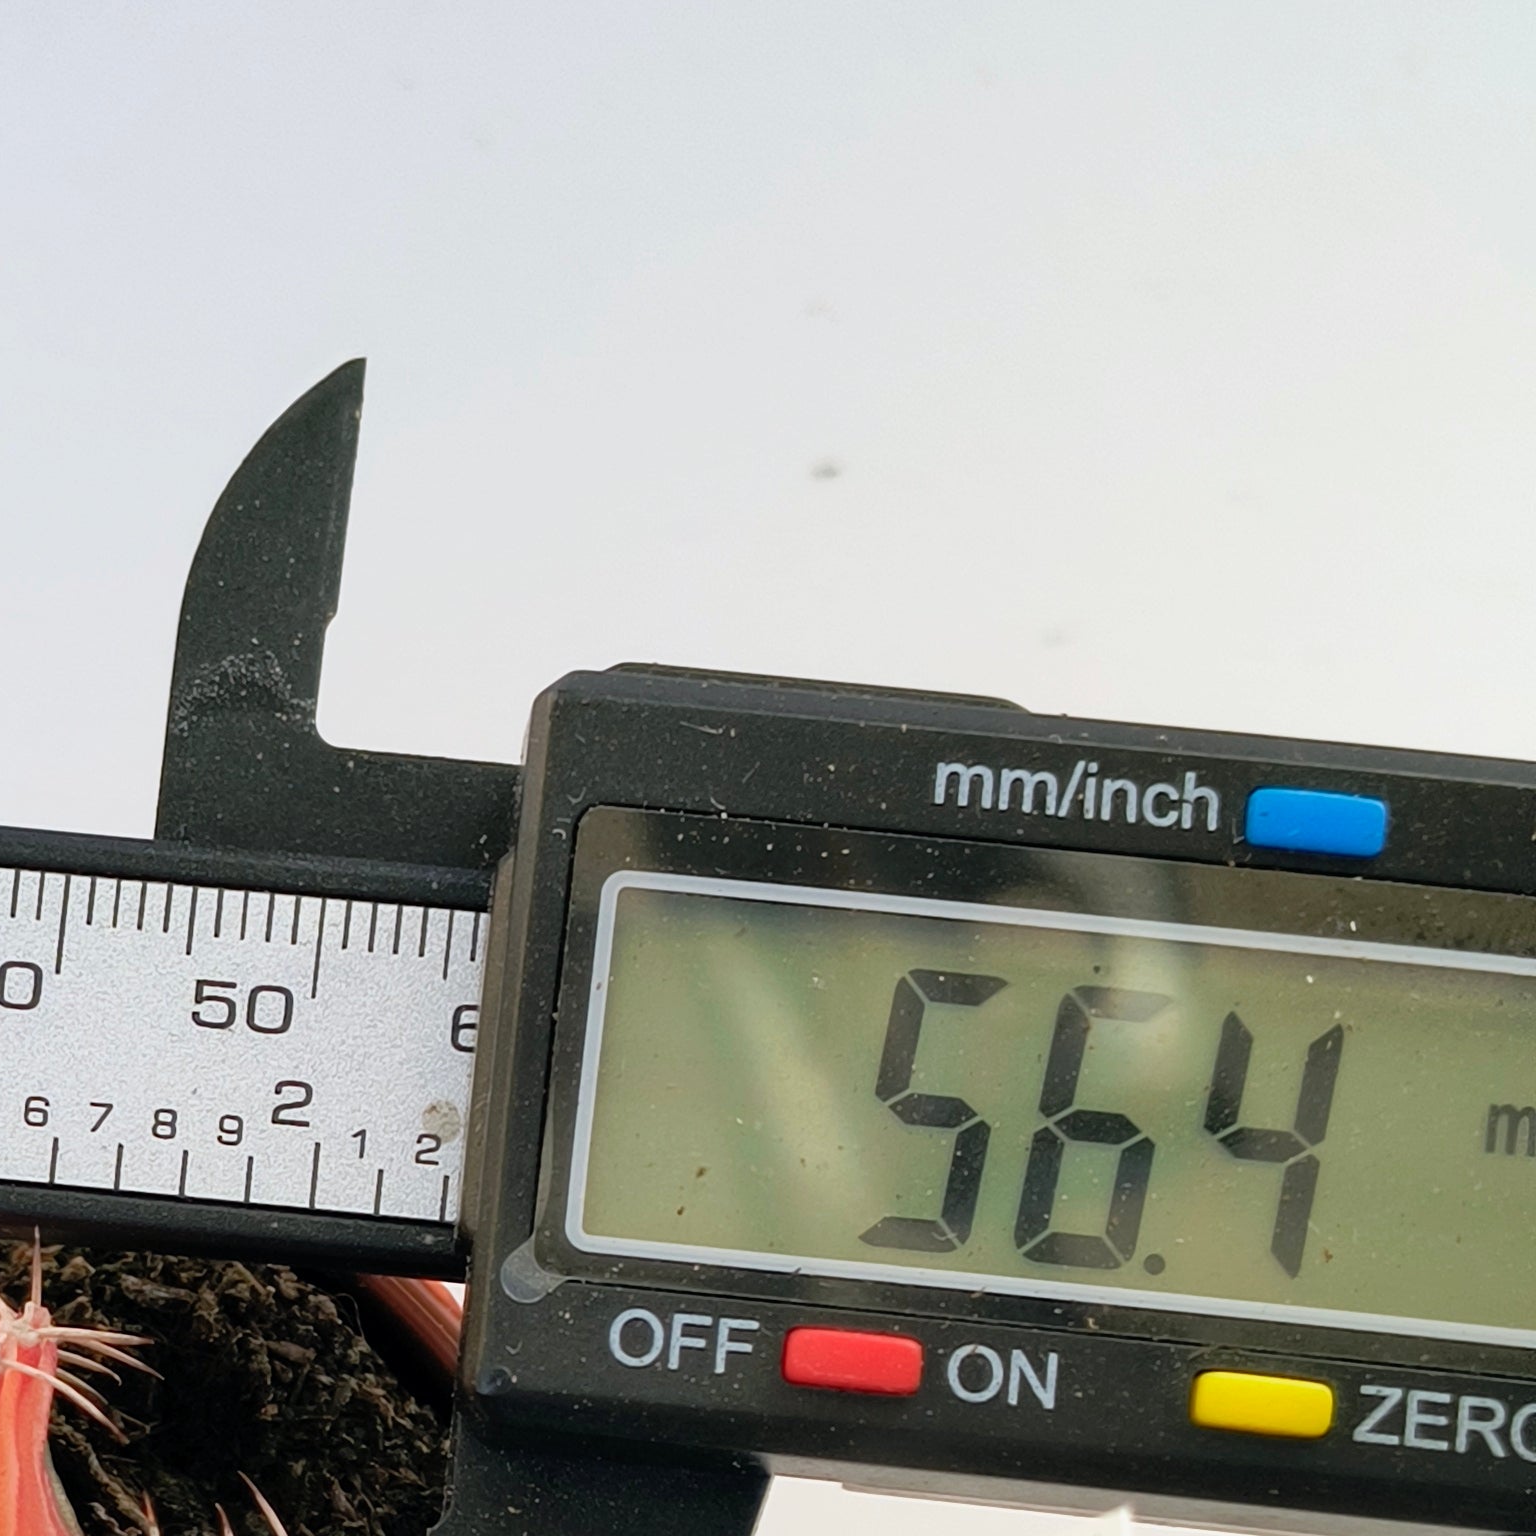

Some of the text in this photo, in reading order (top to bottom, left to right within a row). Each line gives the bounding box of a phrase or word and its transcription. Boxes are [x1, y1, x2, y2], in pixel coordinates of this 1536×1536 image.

[935, 760, 1219, 831] mm/inch
[191, 979, 294, 1035] 50
[23, 1096, 50, 1127] 6
[89, 1101, 114, 1133] 7
[151, 1108, 178, 1140] 8
[216, 1114, 244, 1146] 9
[271, 1080, 313, 1128] 2
[351, 1128, 367, 1159] 1
[414, 1133, 442, 1166] 2
[859, 967, 1345, 1278] 56.4
[609, 1308, 761, 1374] OFF
[947, 1344, 1058, 1410] ON
